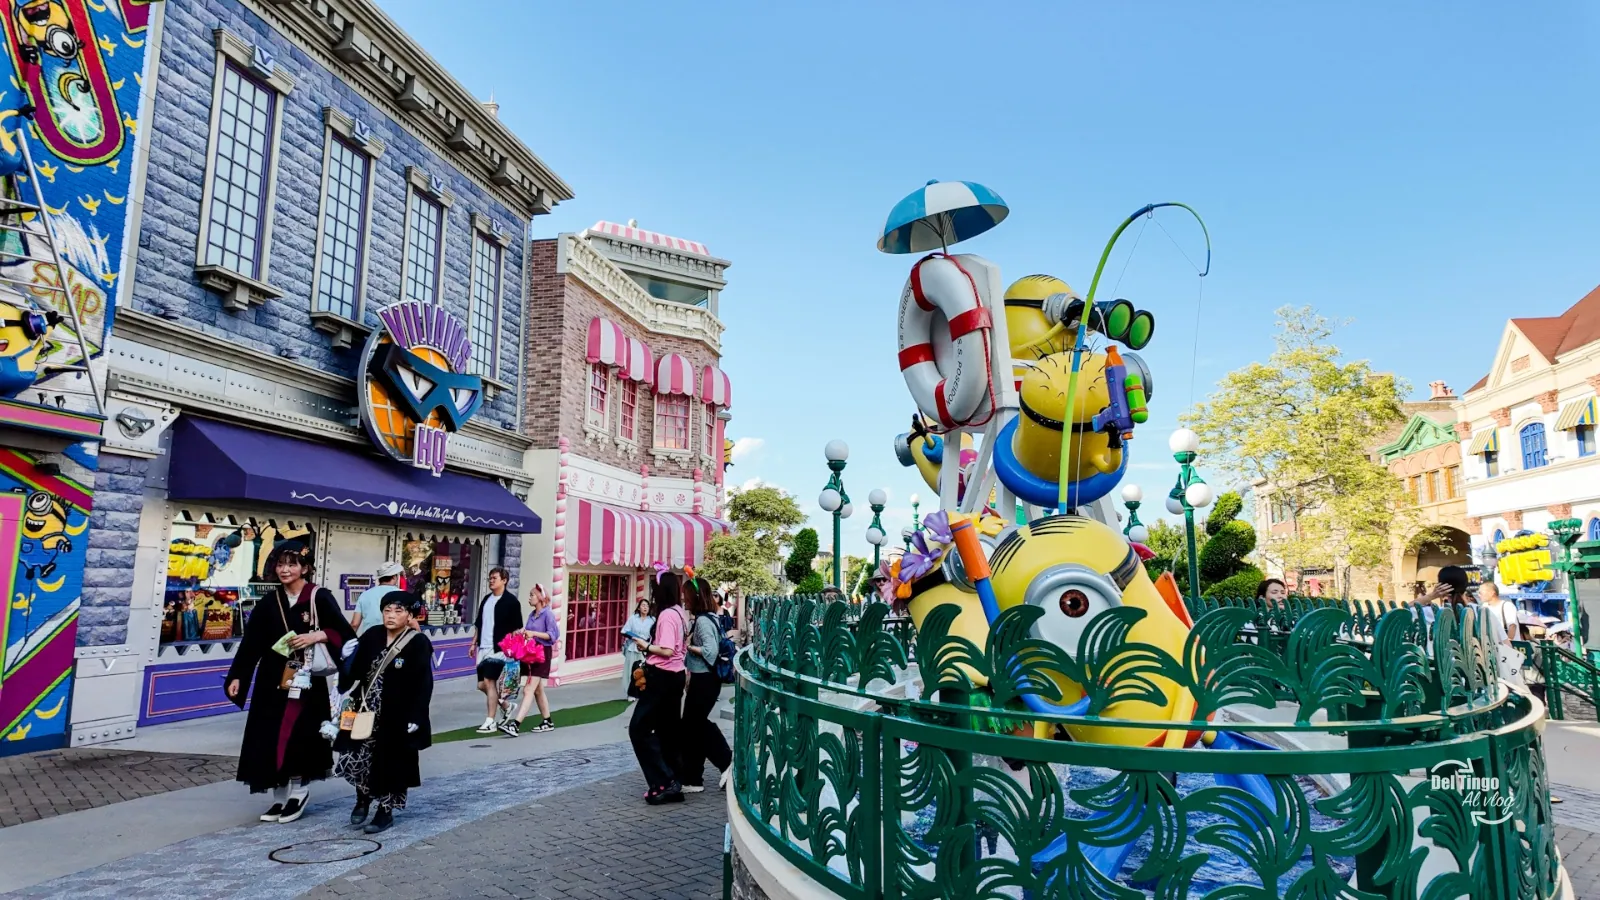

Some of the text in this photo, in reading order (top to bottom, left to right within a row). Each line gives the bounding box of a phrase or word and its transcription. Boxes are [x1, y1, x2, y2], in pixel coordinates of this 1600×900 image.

[900, 283, 914, 330] POSEIDON
[376, 299, 473, 375] VILLAINS
[945, 360, 963, 406] POSEIDON
[414, 423, 447, 477] HQ
[399, 502, 456, 522] Goods for the No-Good
